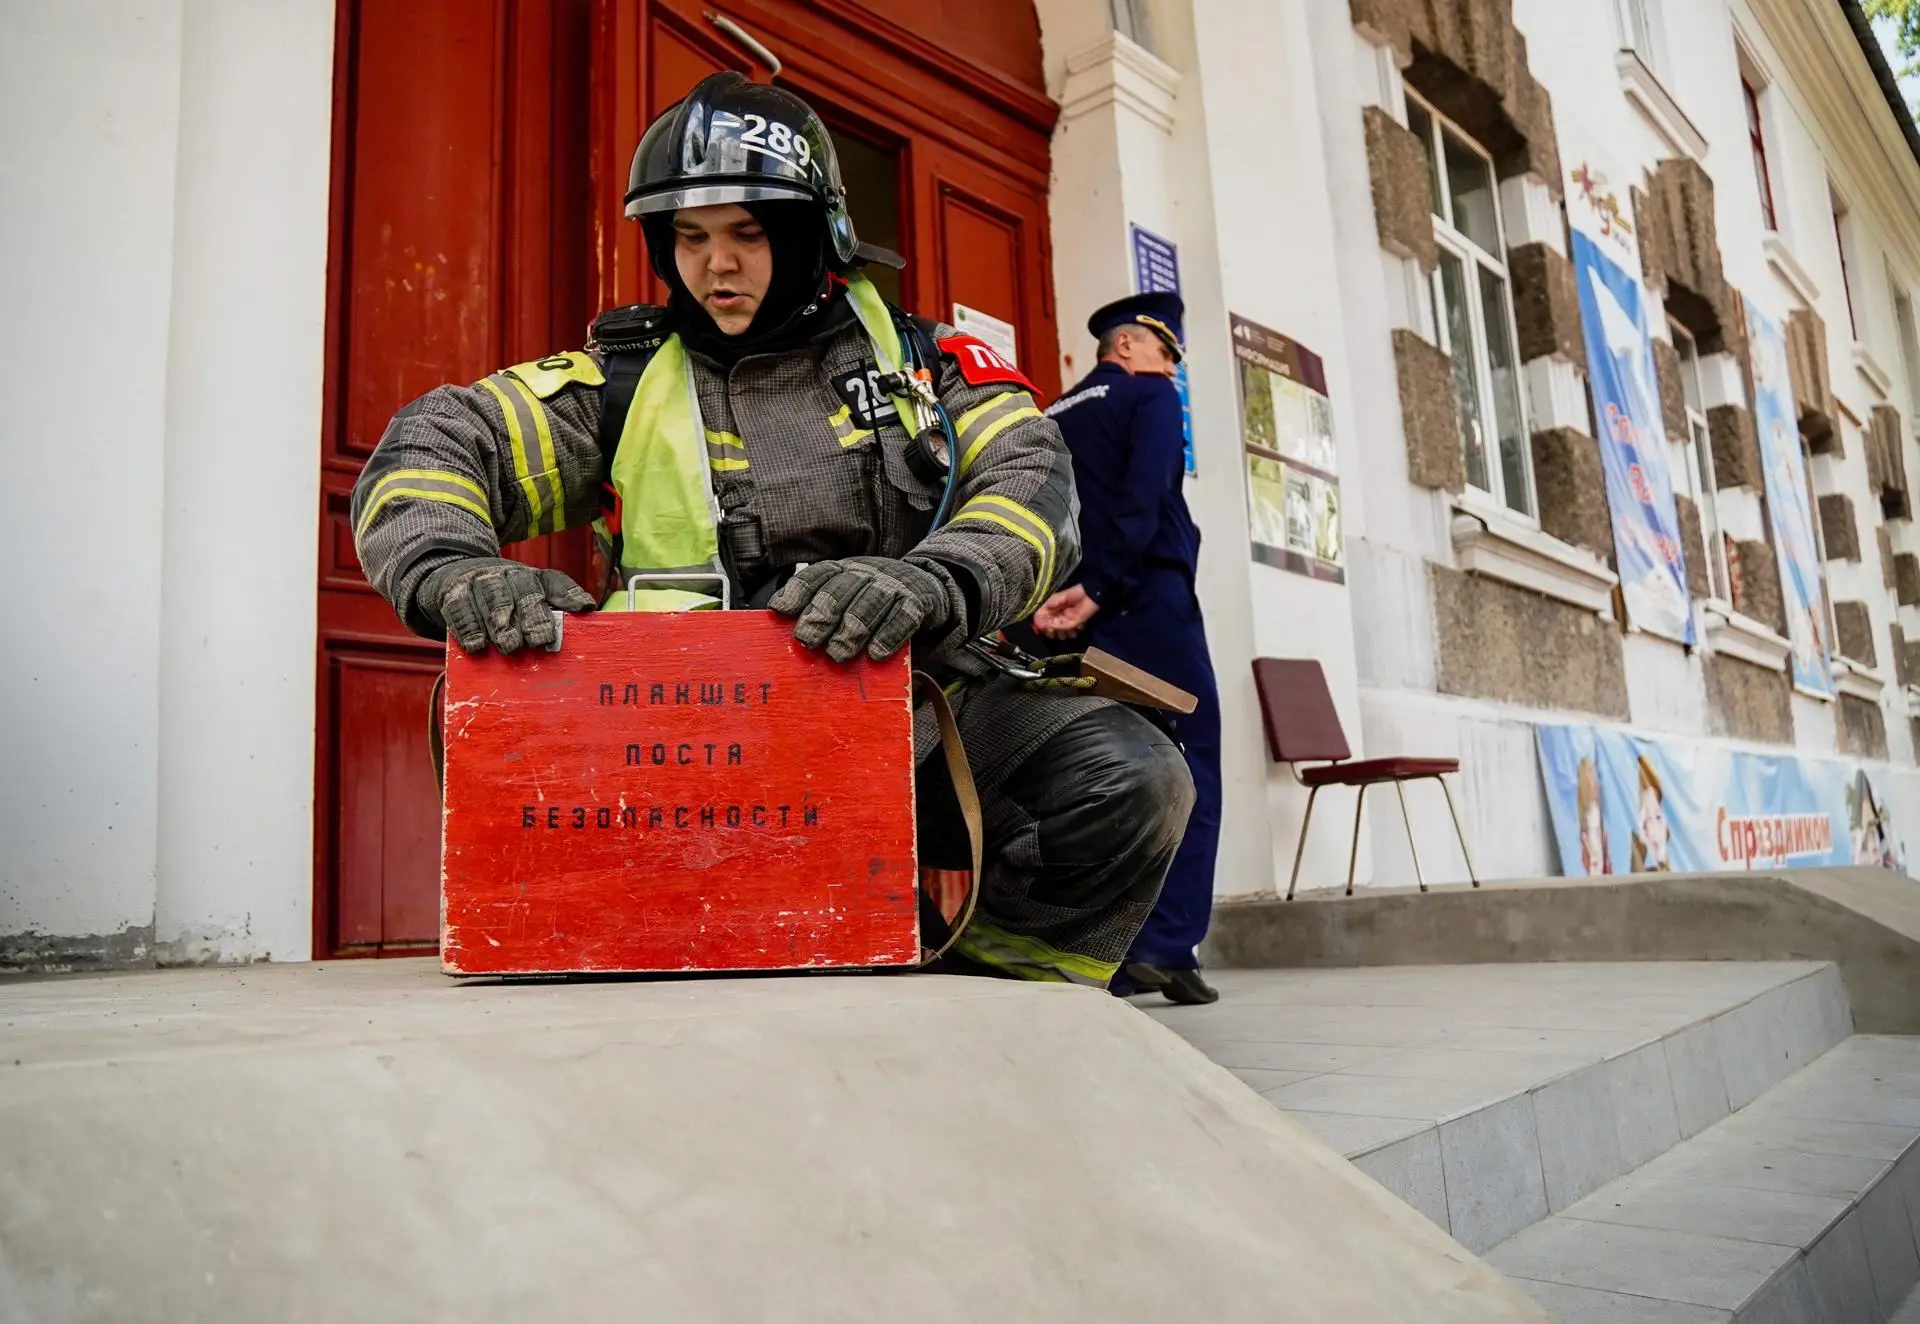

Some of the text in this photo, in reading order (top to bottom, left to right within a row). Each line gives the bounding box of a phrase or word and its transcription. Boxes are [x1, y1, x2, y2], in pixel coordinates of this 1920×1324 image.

[740, 114, 811, 167] 289
[599, 683, 772, 705] ПЛАНШЕТ
[625, 743, 742, 765] ПОСТА
[522, 804, 819, 829] БЕЗОПАСНОСТИ
